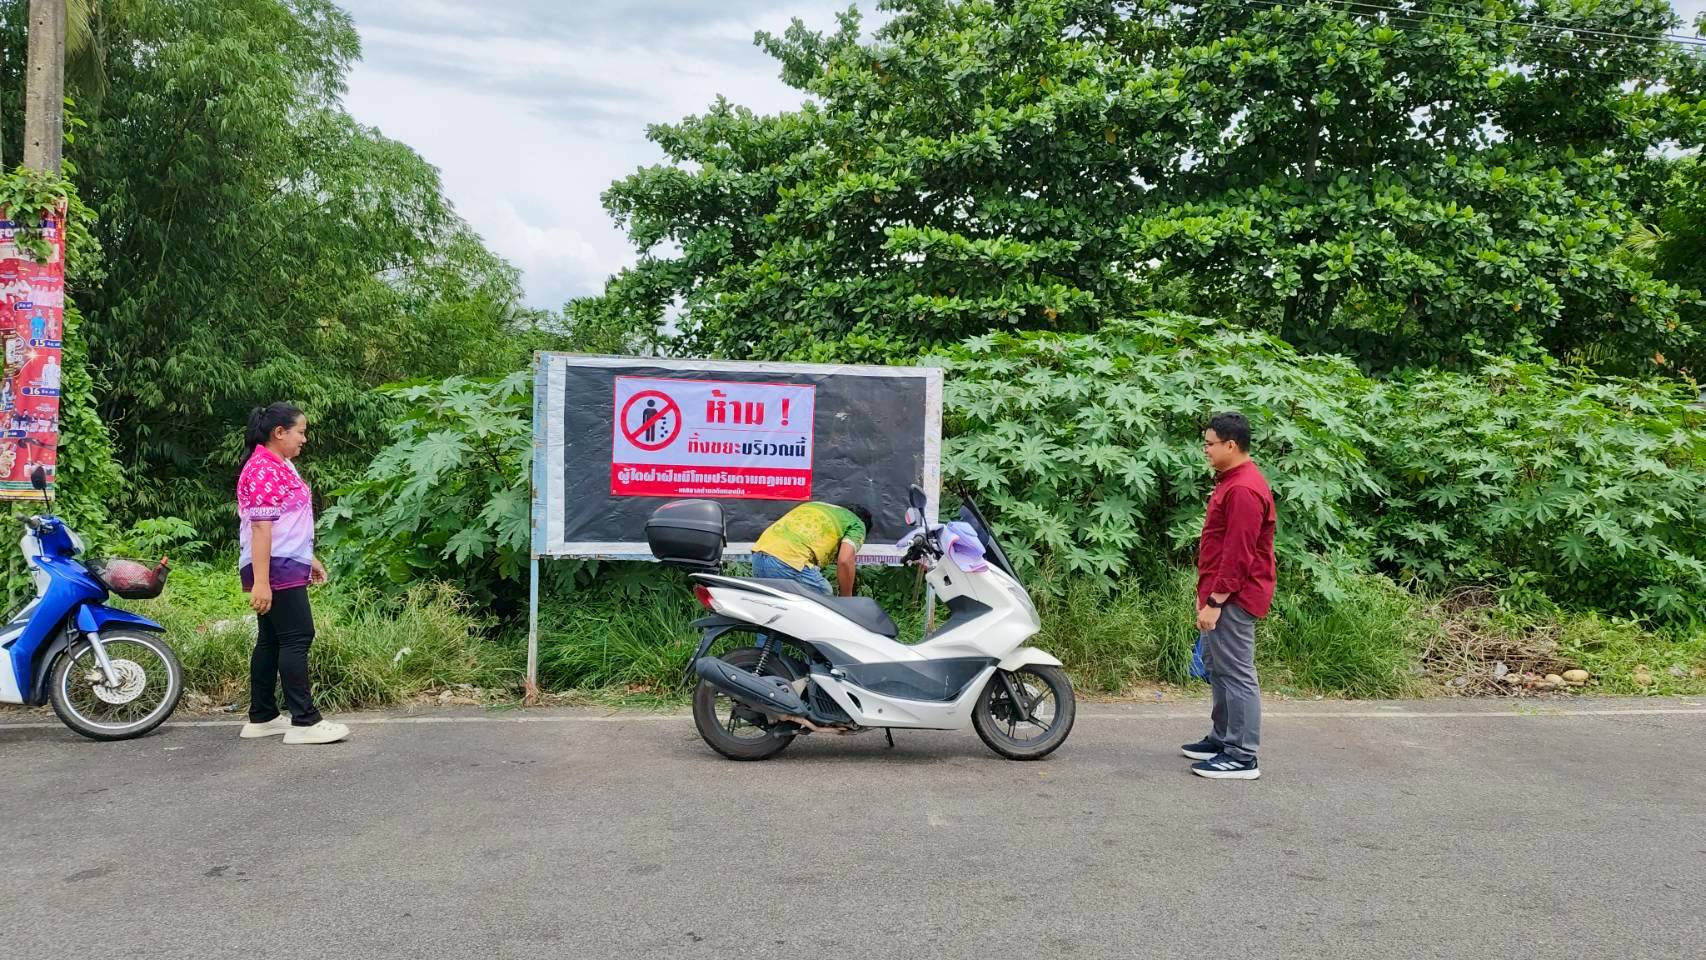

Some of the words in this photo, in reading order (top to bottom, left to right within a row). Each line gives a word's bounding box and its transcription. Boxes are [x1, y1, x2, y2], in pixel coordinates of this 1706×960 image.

[706, 389, 765, 425] ห้าม
[781, 398, 790, 426] !
[688, 432, 807, 457] ทิ้งขยะบริเวณนี้
